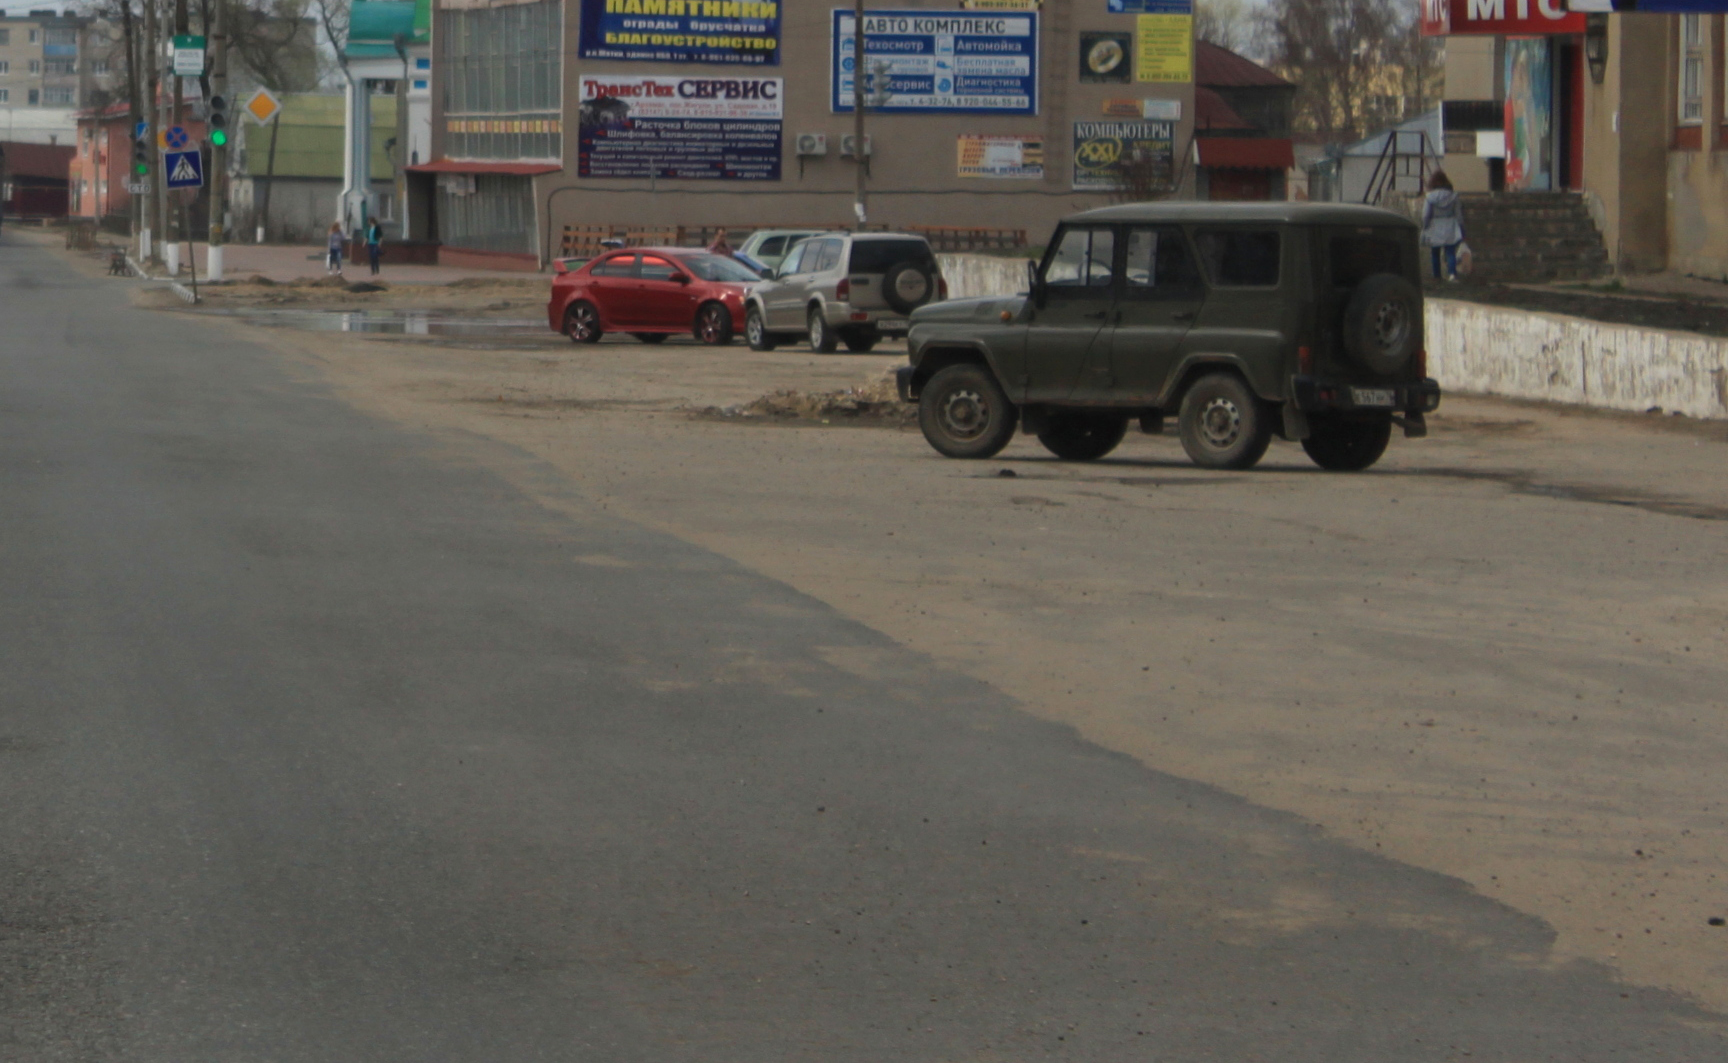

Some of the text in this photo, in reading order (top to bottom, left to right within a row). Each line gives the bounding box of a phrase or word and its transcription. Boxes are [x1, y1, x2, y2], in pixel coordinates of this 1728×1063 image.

[623, 19, 766, 32] ограды брусчатка
[865, 19, 1006, 34] АВТО КОМПЛЕКС
[605, 32, 777, 50] БЛАГОУСТРОЙСТВО
[956, 41, 1022, 52] Автомойка
[956, 58, 1016, 67] Бесплатная
[956, 78, 1021, 87] Диагностика
[677, 80, 777, 100] СЕРВИС
[635, 121, 780, 132] Расточка блоков цилиндров
[1077, 123, 1170, 139] КОМПЬЮТЕРЫ
